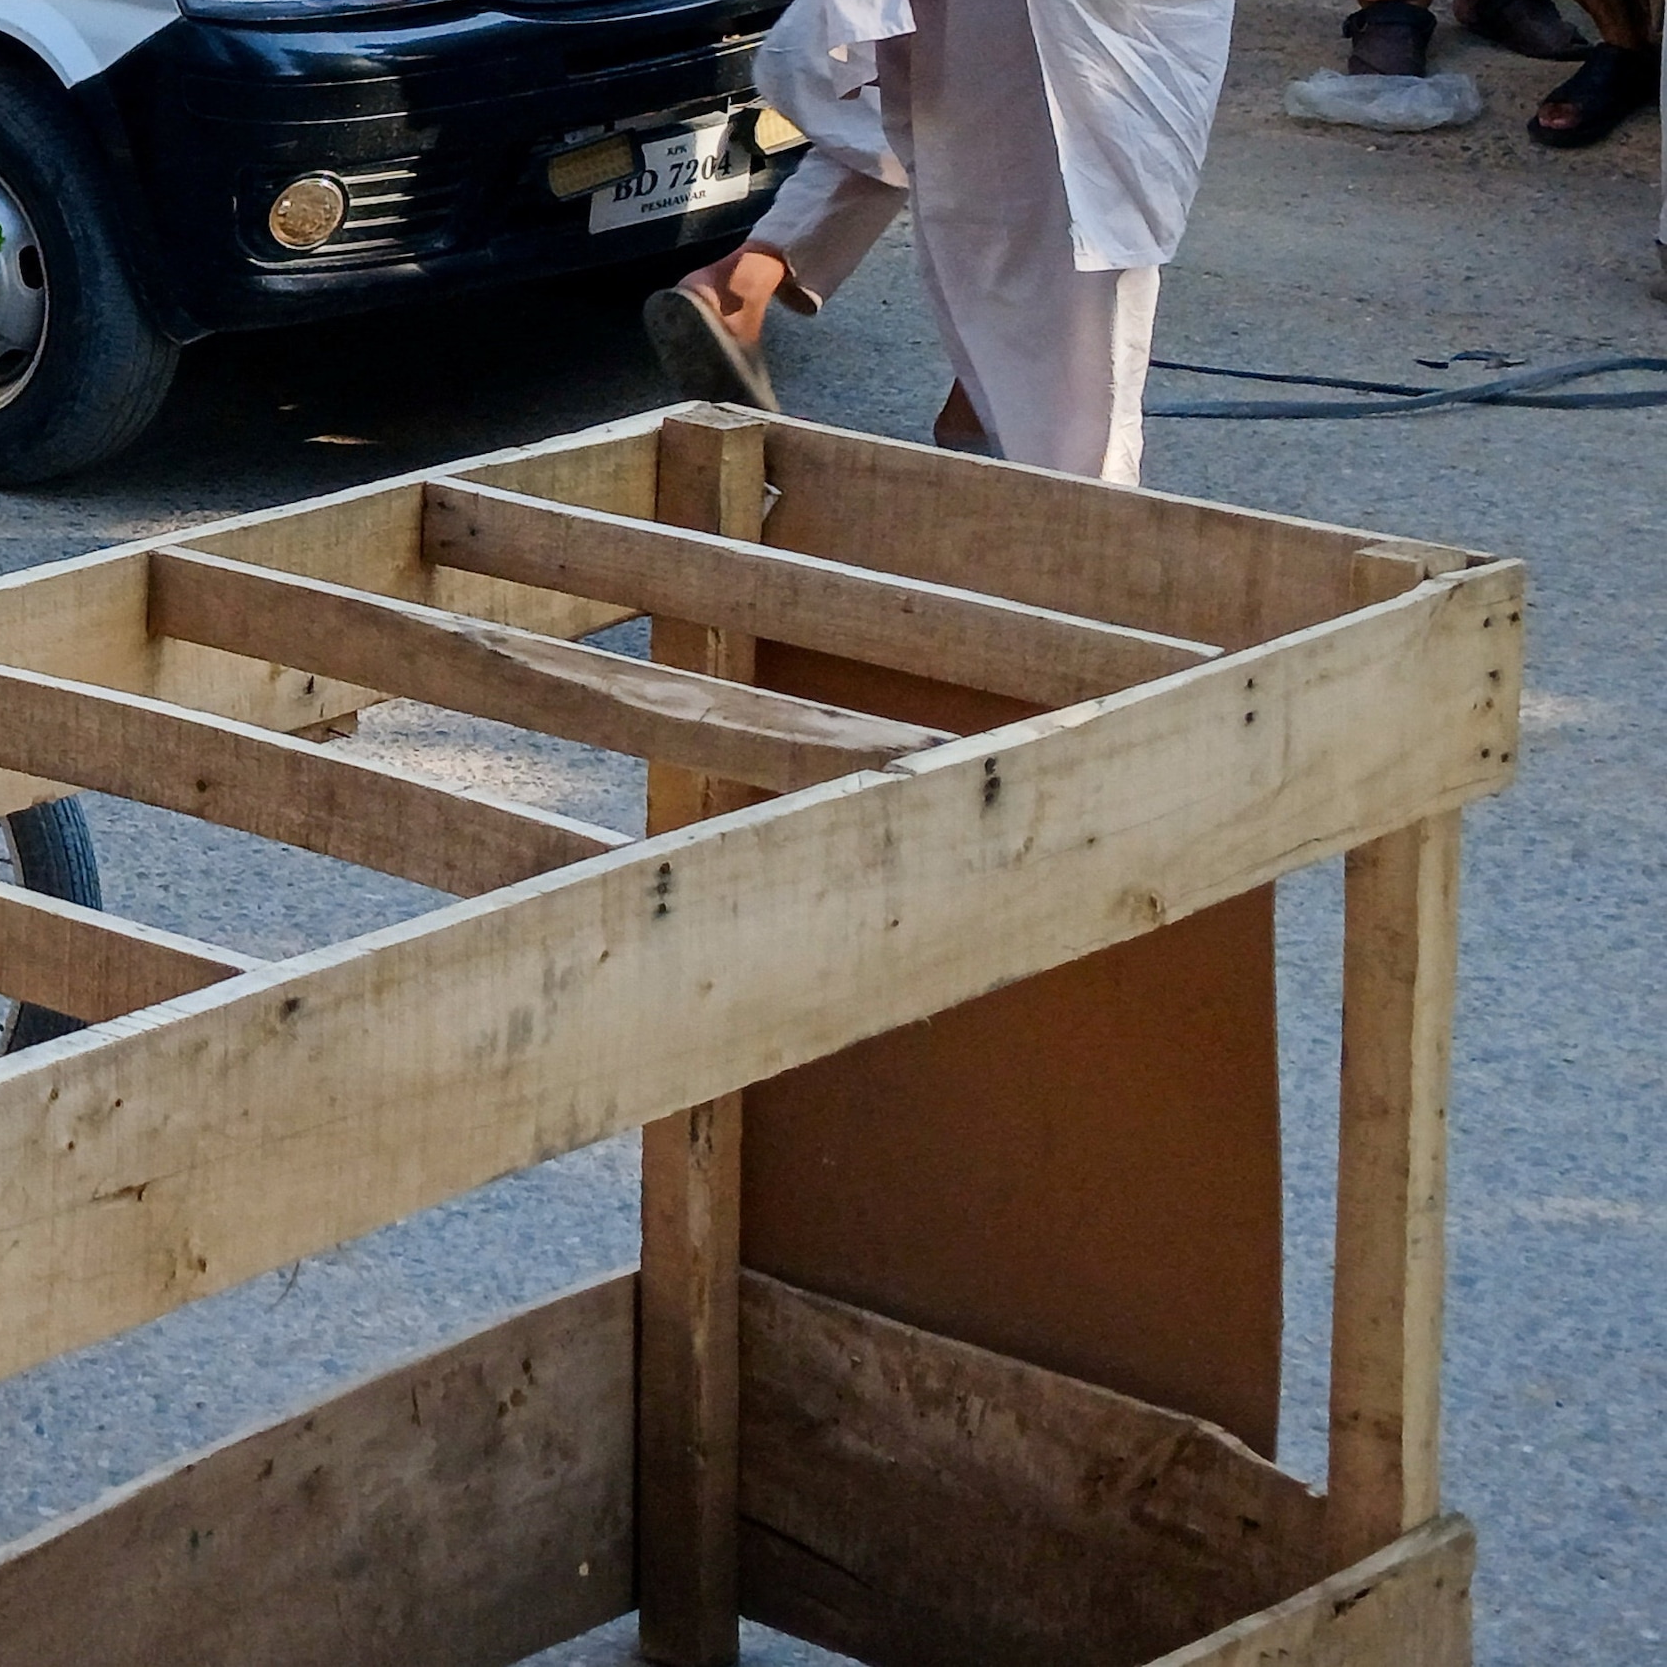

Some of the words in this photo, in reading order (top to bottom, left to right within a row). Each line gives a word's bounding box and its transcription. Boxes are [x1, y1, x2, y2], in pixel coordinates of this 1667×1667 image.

[613, 169, 659, 203] BD
[668, 150, 732, 190] 7204
[641, 189, 707, 213] PESHAWAR
